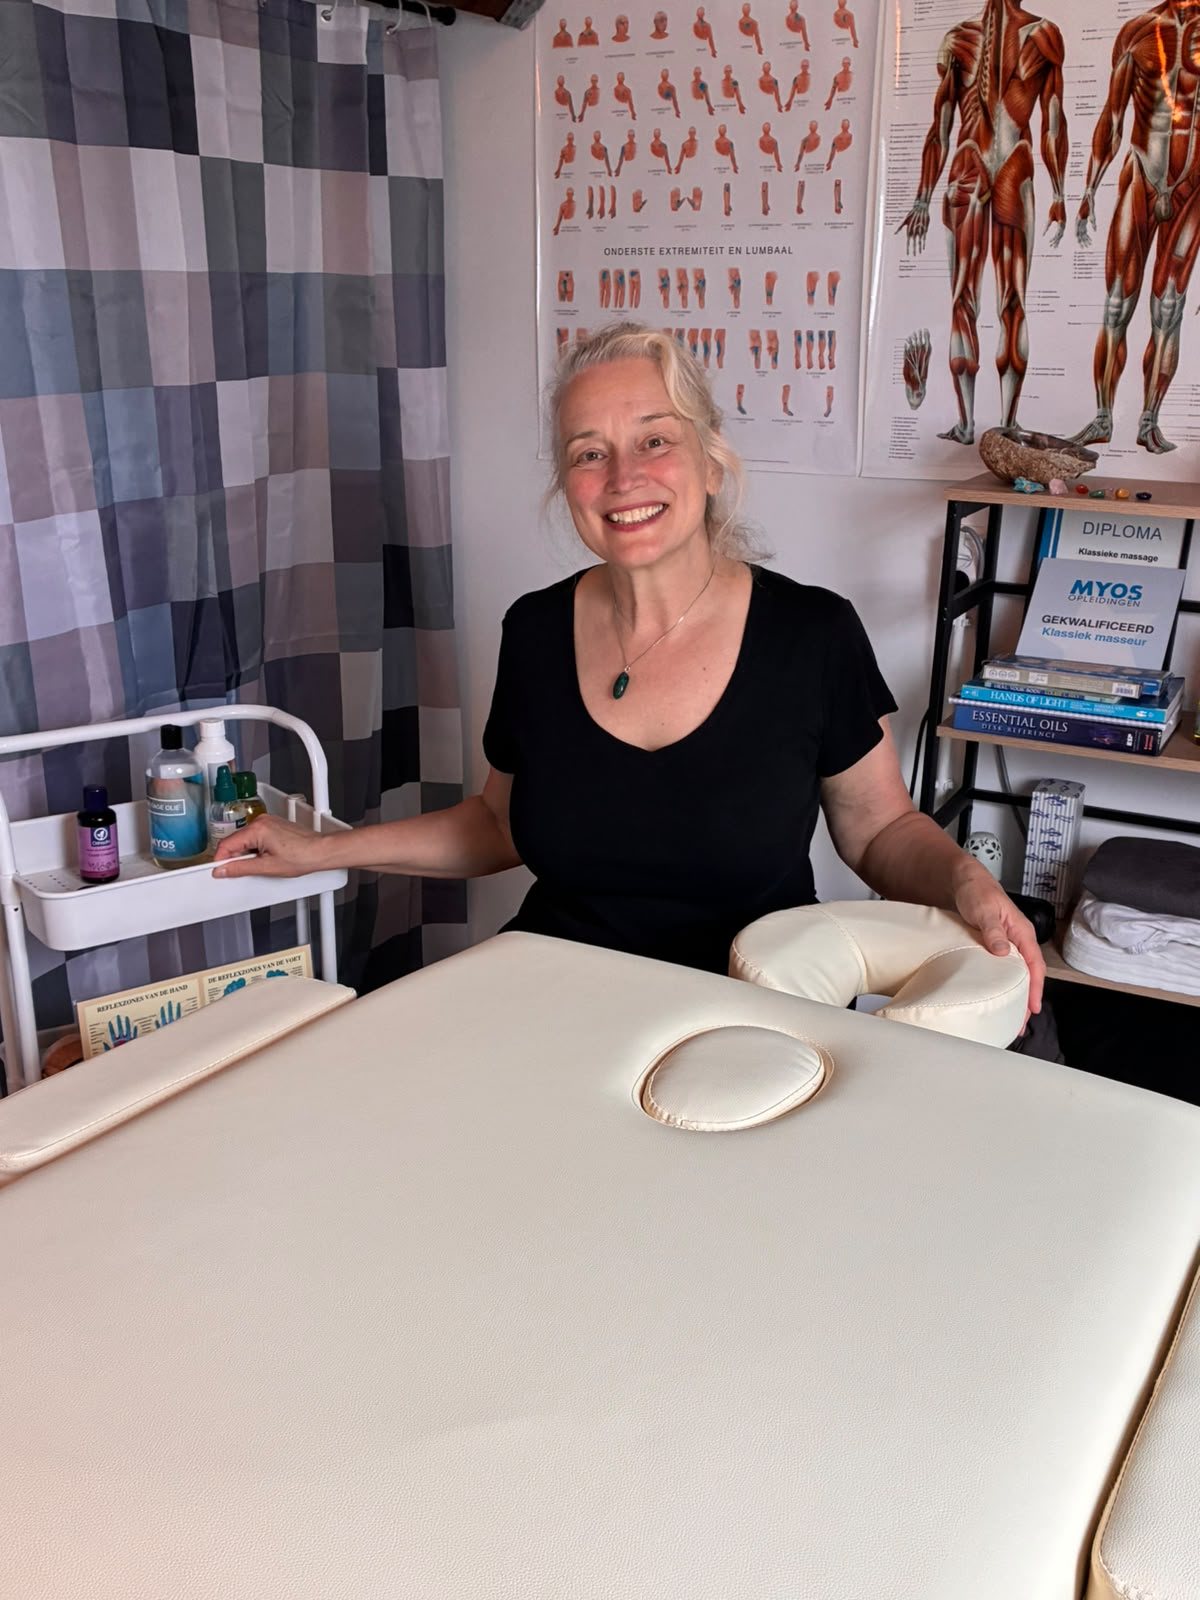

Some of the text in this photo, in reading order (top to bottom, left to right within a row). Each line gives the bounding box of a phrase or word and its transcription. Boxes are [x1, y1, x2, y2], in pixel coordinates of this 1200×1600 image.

[603, 246, 793, 256] ONDERSTE EXTREMITEIT EN LUMBAAL
[1082, 521, 1162, 541] DIPLOMA
[1078, 547, 1159, 563] Klassieke massage
[1070, 579, 1143, 601] MYOS
[1067, 594, 1141, 608] OPLEIDINGEN
[1041, 614, 1155, 634] GEKWALIFICEERD
[1041, 627, 1148, 647] Klassiek masseur
[990, 690, 1025, 702] HANDS
[1026, 696, 1039, 704] OF
[1040, 696, 1069, 709] LIGHT
[972, 710, 1069, 733] ESSENTIAL OILS
[981, 722, 1056, 739] DESK REFERENCE
[208, 954, 302, 984] DE REFLEXZONES VAN DE VOET
[96, 984, 189, 1013] REFLEXZONES VAN DE HAND
